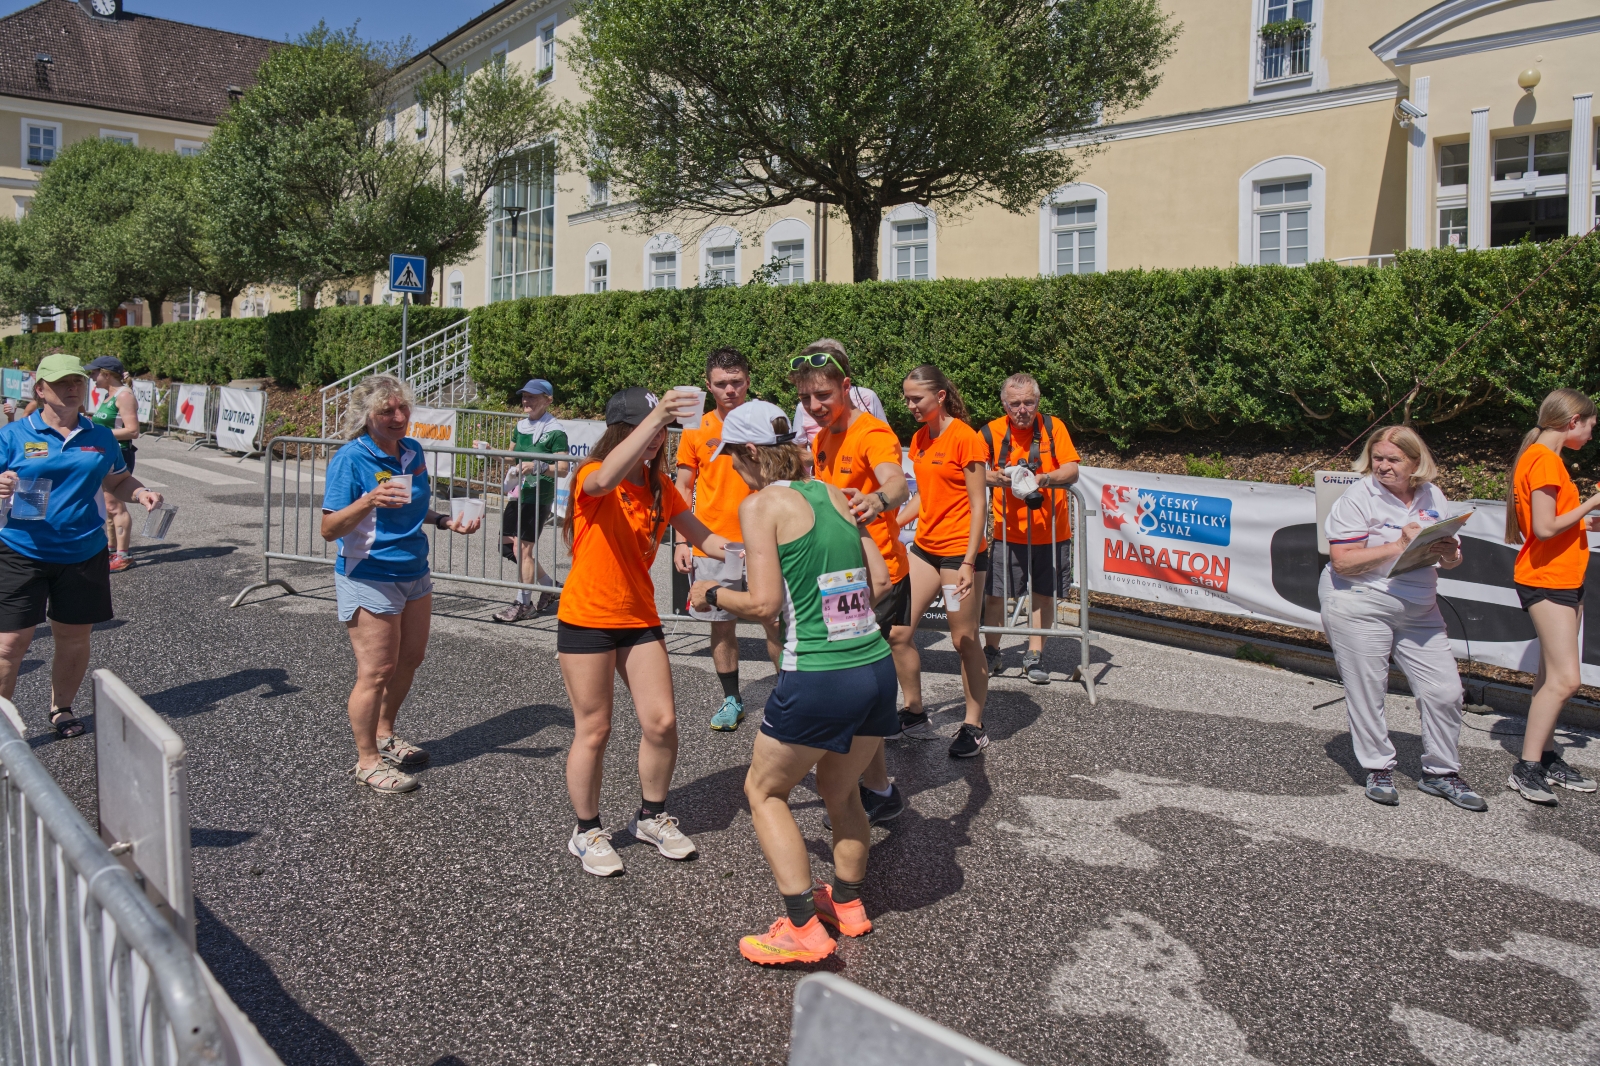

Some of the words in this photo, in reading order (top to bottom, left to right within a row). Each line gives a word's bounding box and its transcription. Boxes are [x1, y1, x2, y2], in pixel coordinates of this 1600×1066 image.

[568, 443, 589, 457] ort
[1159, 494, 1199, 511] ČESKÝ
[1159, 510, 1227, 528] ATLETICKÝ
[1160, 523, 1191, 537] SVAZ
[1104, 537, 1231, 578] MARATON
[1190, 575, 1224, 589] stav
[1165, 584, 1199, 596] jednota
